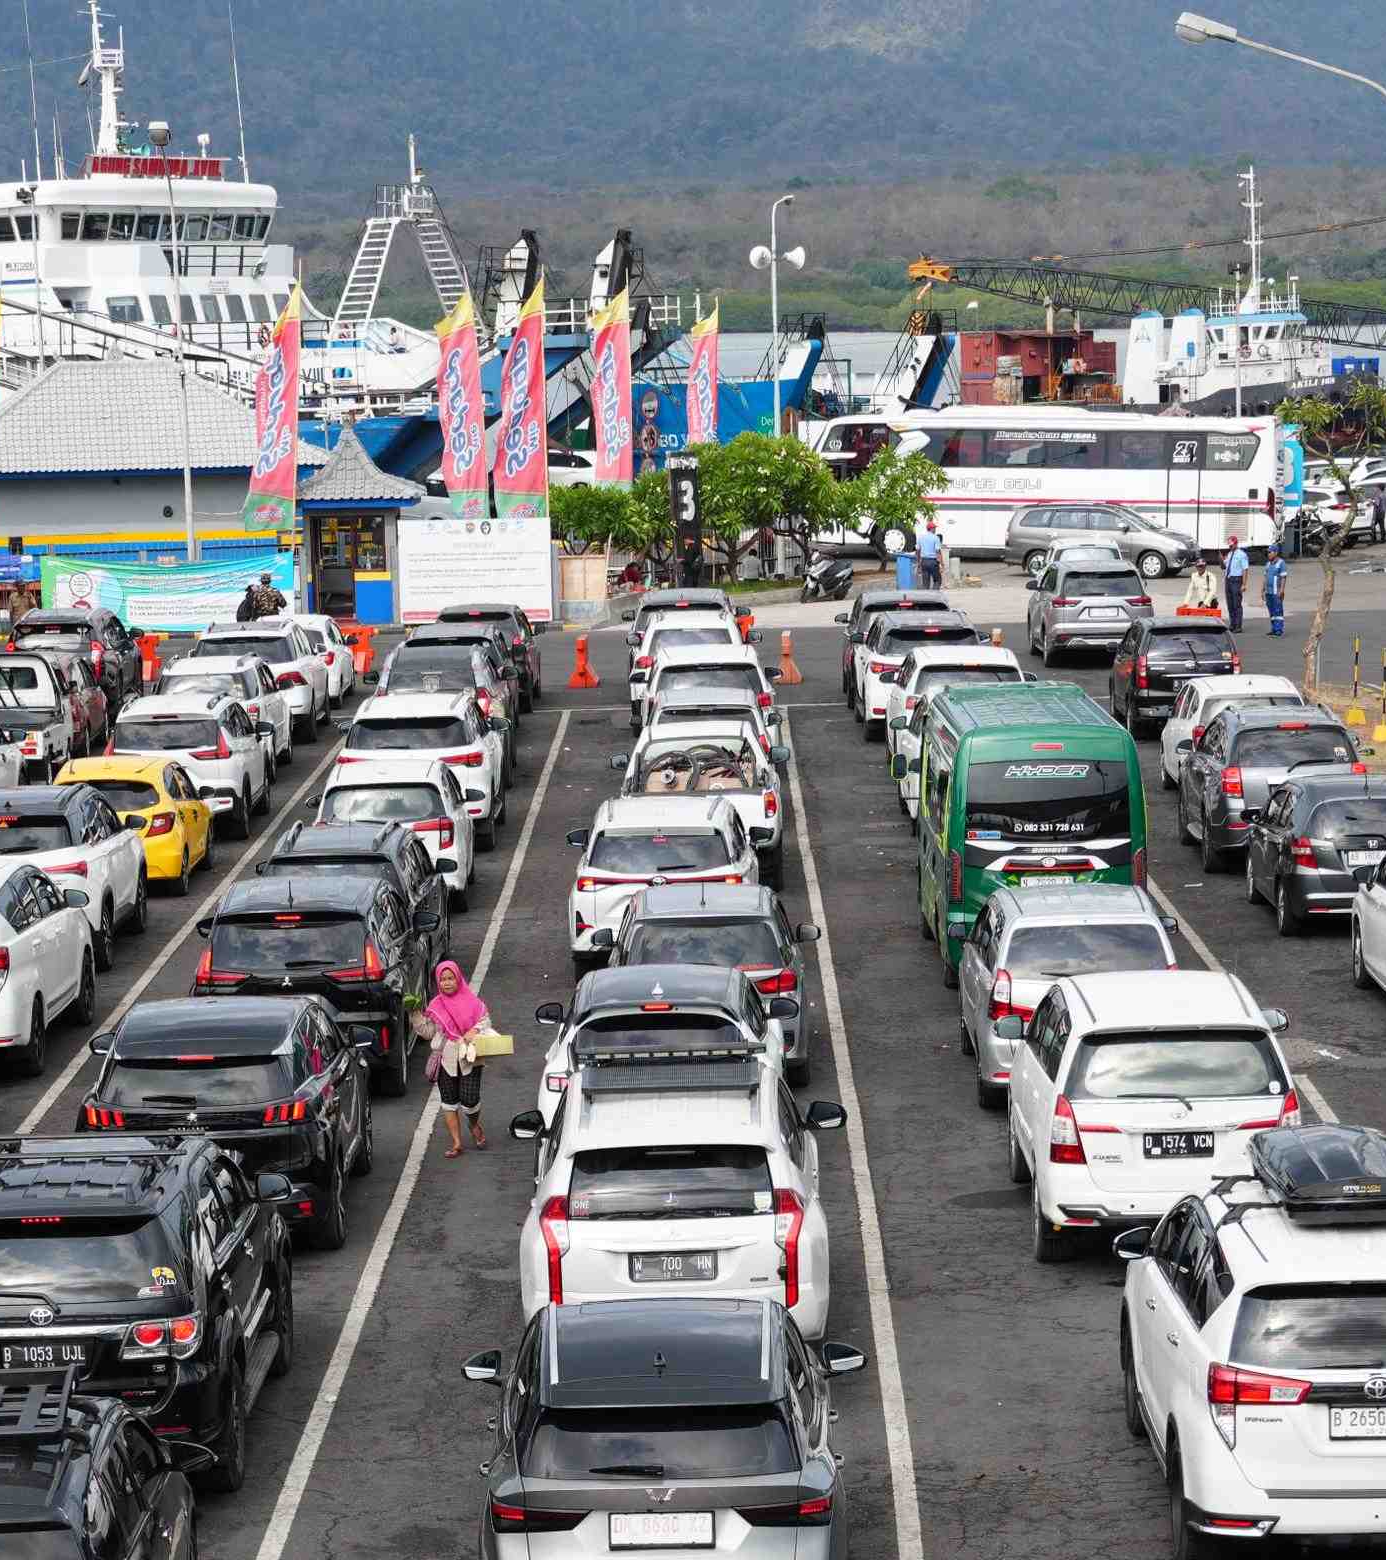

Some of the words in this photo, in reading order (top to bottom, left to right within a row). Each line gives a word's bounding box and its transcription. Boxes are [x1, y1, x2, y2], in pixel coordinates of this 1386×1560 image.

[1145, 1136, 1153, 1149] D
[1162, 1135, 1187, 1149] 1574
[1193, 1134, 1213, 1148] VCN
[633, 1257, 643, 1272] W
[660, 1256, 683, 1271] 700
[697, 1255, 712, 1270] HN
[4, 1347, 12, 1362] B
[23, 1346, 53, 1361] 1053
[62, 1345, 86, 1361] UJL
[1333, 1412, 1343, 1428] B
[1349, 1410, 1386, 1428] 2650
